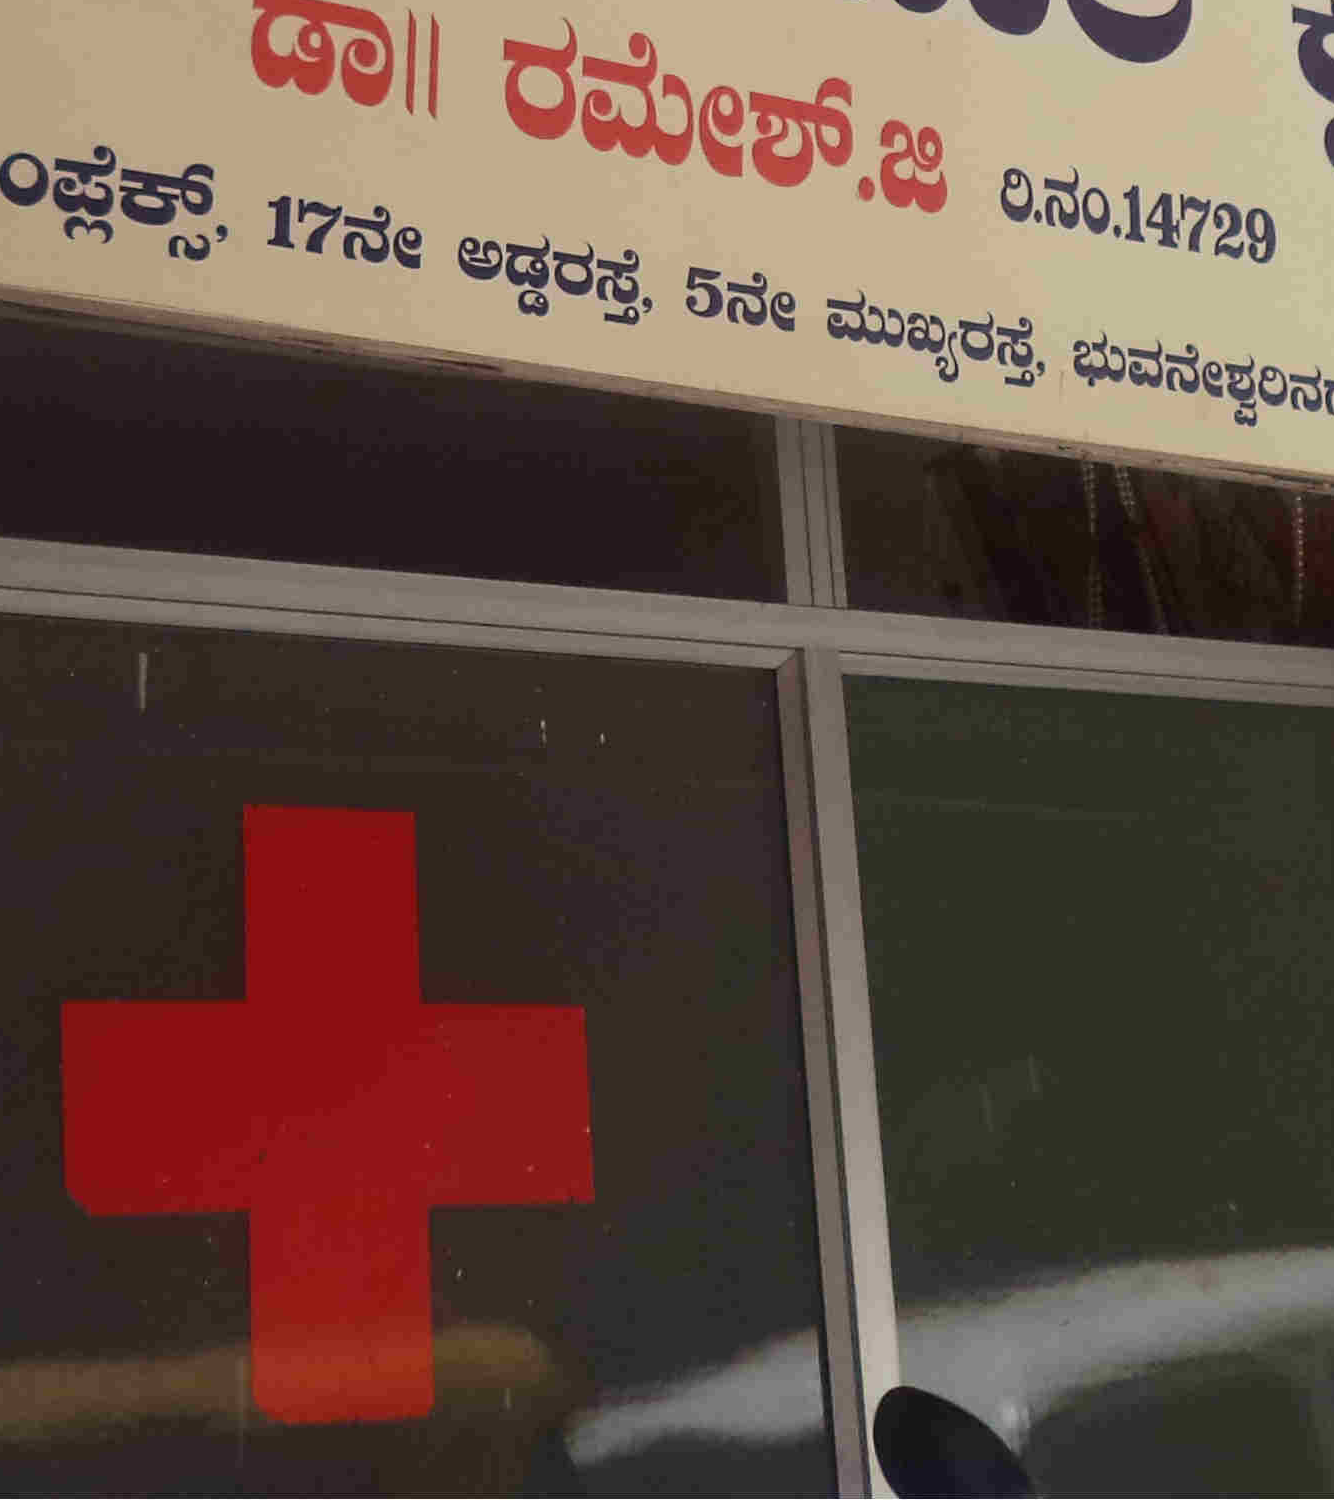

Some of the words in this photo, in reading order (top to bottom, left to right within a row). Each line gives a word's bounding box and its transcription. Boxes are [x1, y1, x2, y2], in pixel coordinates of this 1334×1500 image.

[266, 194, 423, 270] 17ನೇ
[456, 233, 654, 326] ಅಡ್ಡರಸ್ತೆ,
[685, 265, 797, 333] 5ನೇ
[826, 288, 1046, 388] ಮುಖ್ಯರಸ್ತೆ,
